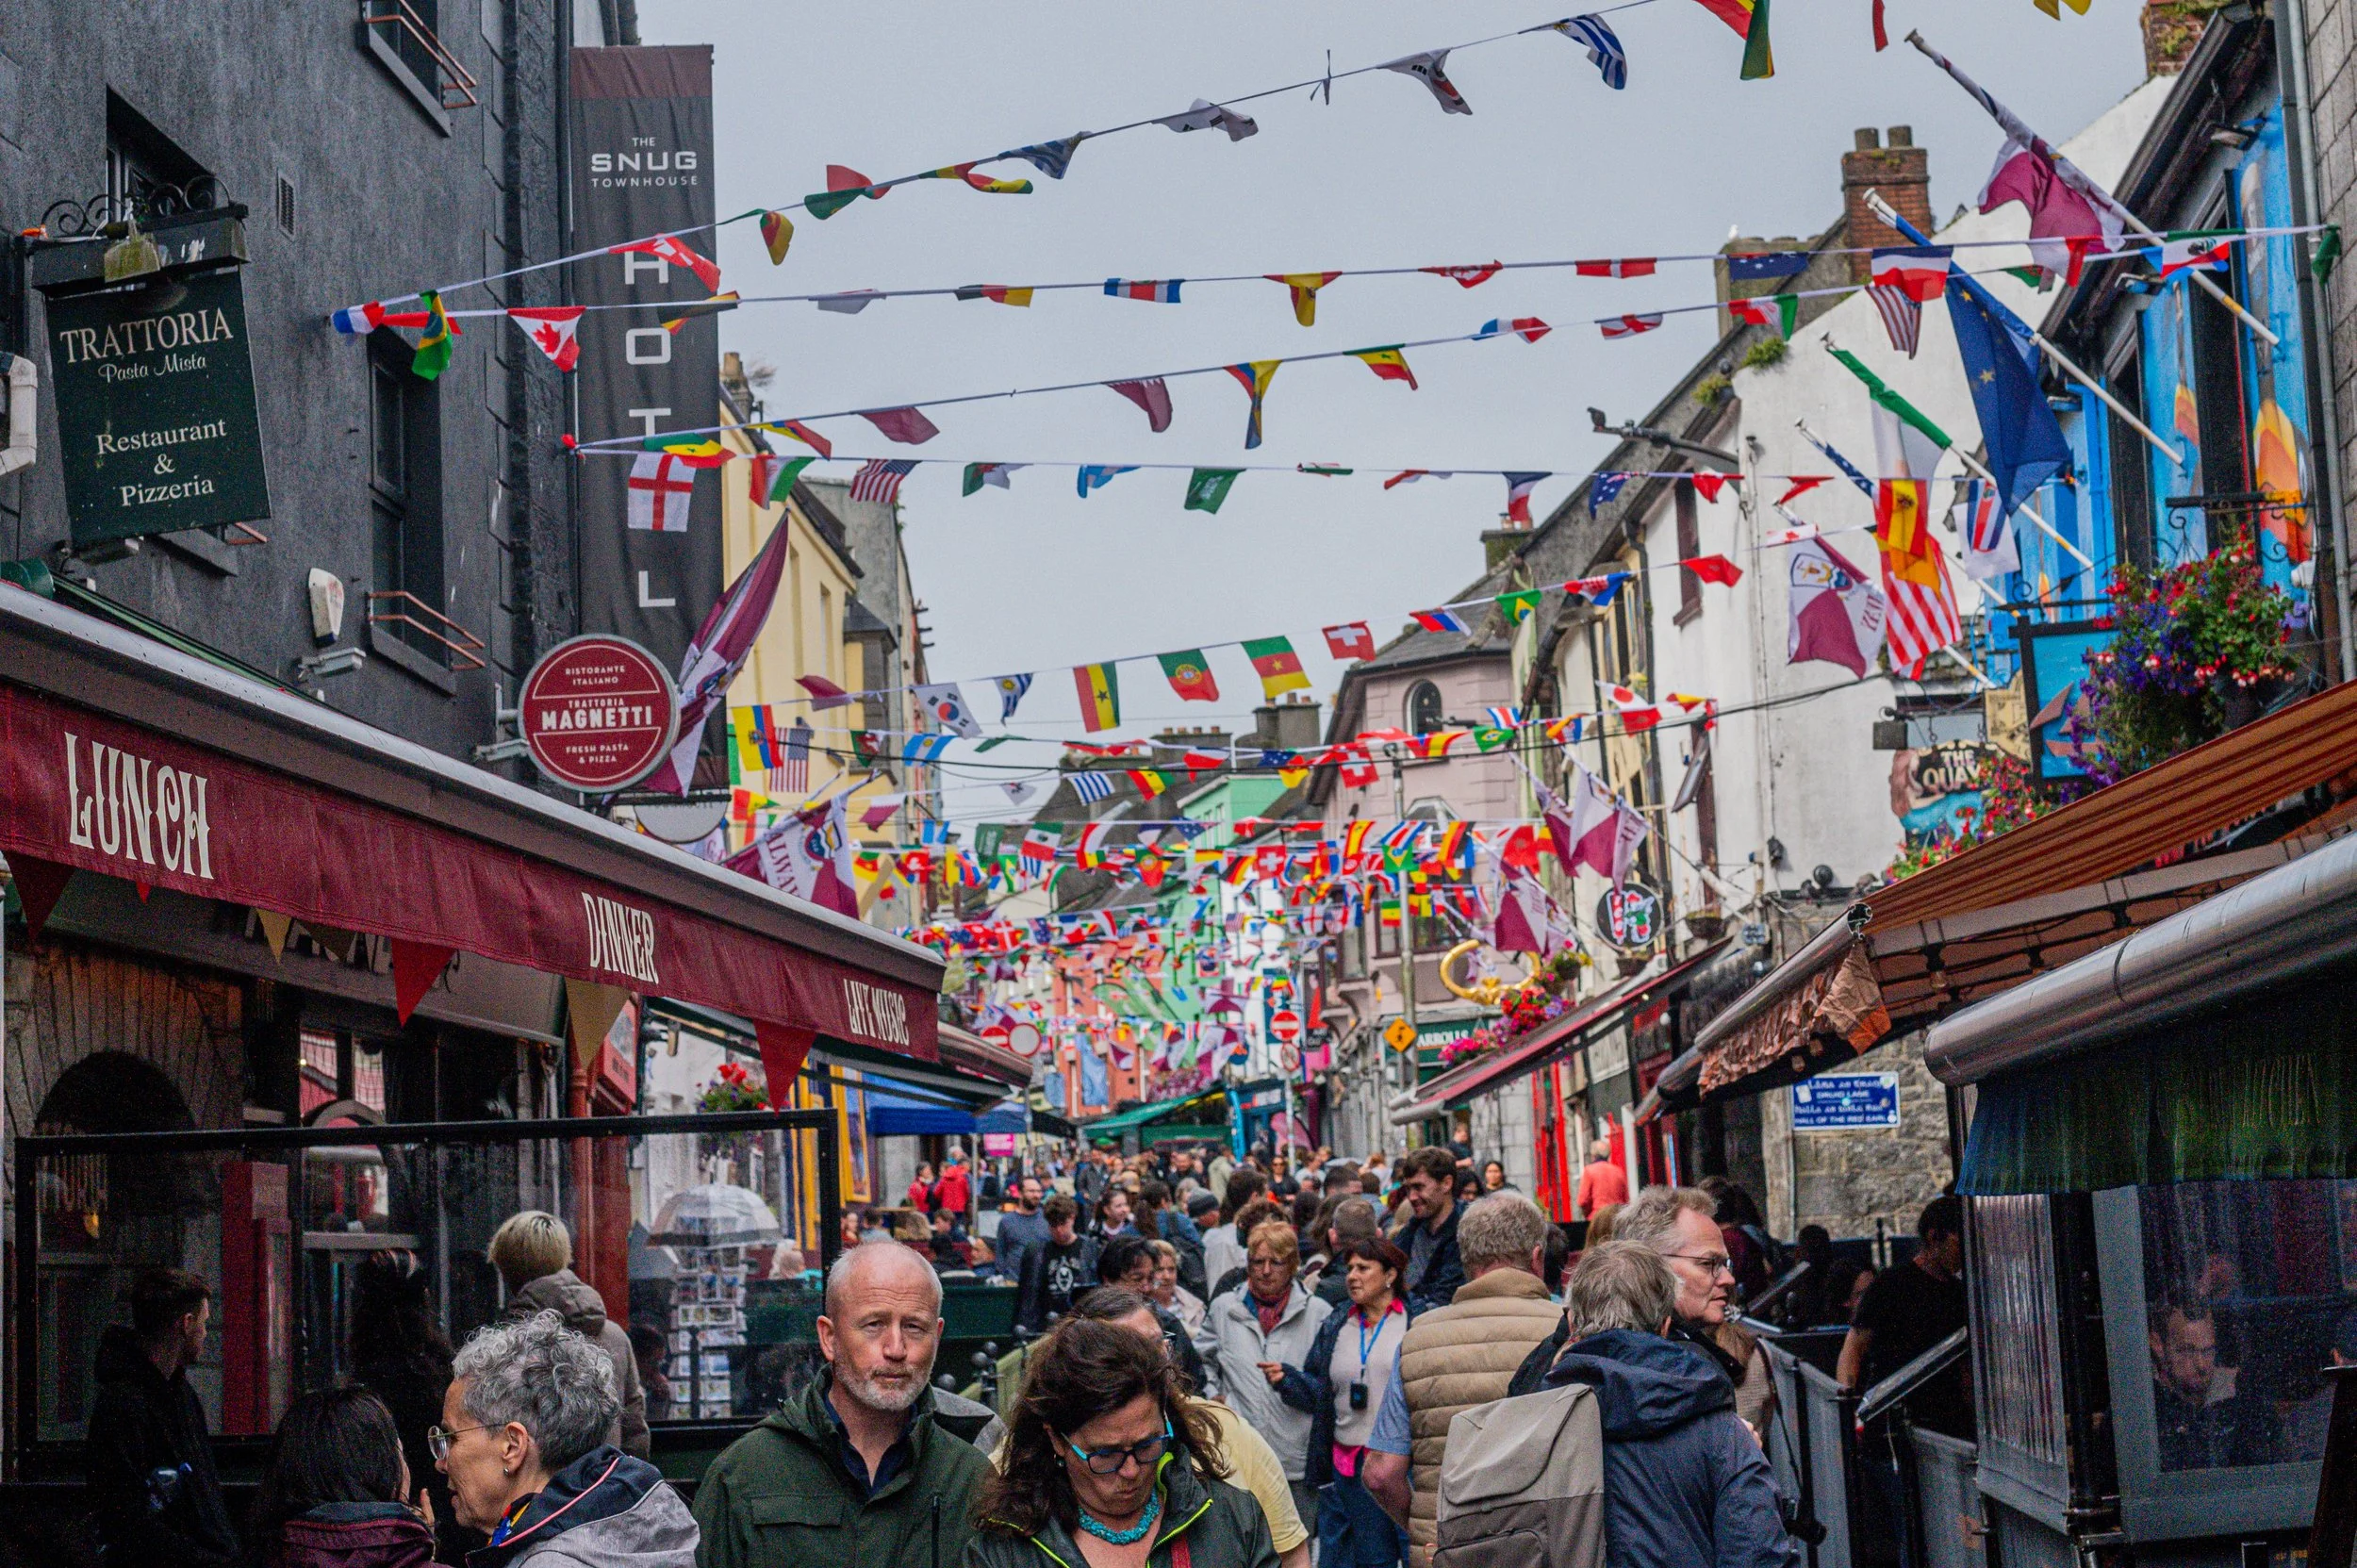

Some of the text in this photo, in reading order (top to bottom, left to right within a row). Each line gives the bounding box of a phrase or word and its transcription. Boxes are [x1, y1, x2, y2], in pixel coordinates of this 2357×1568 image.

[632, 137, 656, 147] THE
[591, 151, 698, 172] SNUG
[591, 175, 699, 188] TOWNHOUSE
[59, 307, 234, 364] TRATTORIA
[98, 353, 207, 383] Pasta Mista
[95, 419, 228, 455] Restaurant
[624, 250, 677, 608] HOTL
[154, 454, 176, 474] &
[120, 474, 215, 506] Pizzeria
[566, 665, 626, 675] RISTORANTE
[573, 676, 618, 685] ITALIANO
[569, 698, 625, 708] TRATTORIA
[541, 706, 652, 731] MAGNETTI
[566, 743, 629, 753] FRESH PASTA
[1940, 750, 1976, 767] THE
[588, 755, 618, 764] PIZZA
[1922, 765, 1981, 791] QUAY
[64, 731, 214, 880] LUNCH
[581, 891, 659, 984] DINNER
[843, 979, 910, 1047] LIVE MUSIC
[1417, 1029, 1469, 1047] ARROLLS
